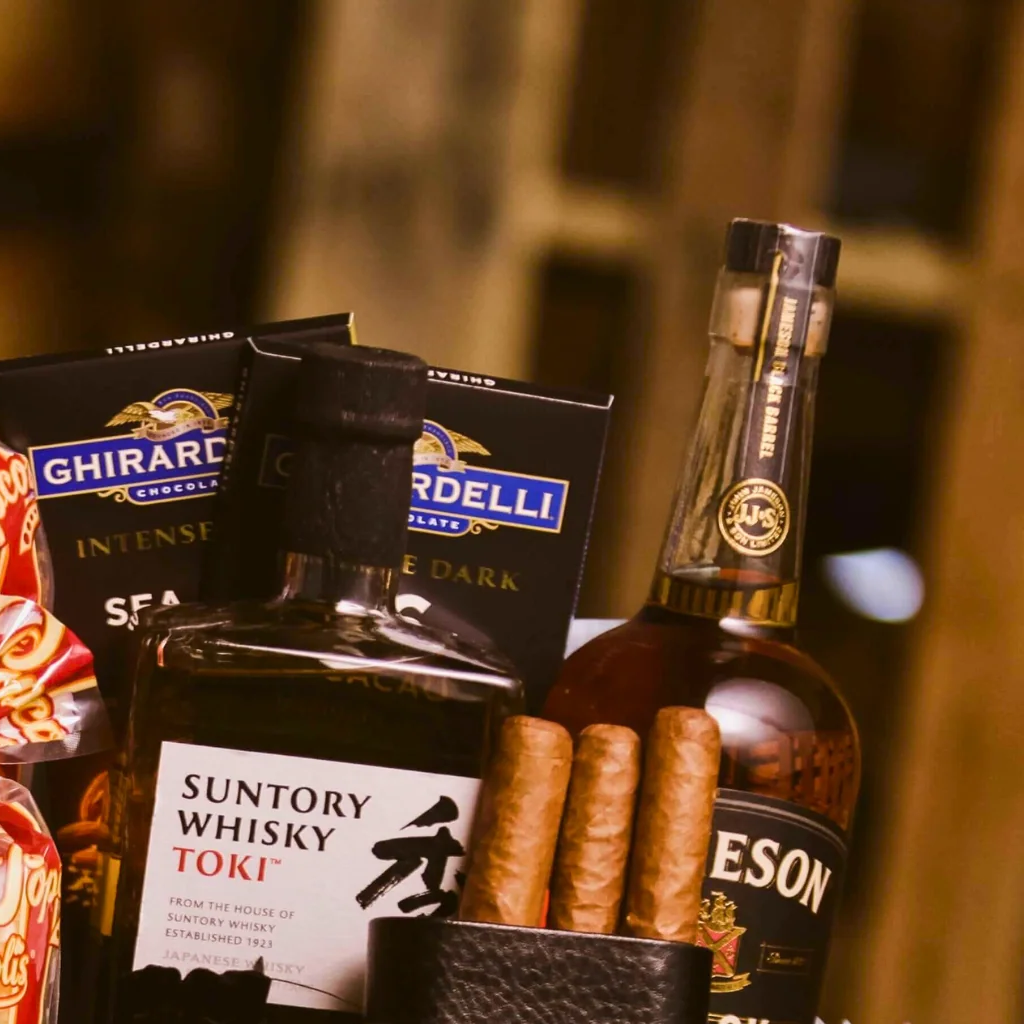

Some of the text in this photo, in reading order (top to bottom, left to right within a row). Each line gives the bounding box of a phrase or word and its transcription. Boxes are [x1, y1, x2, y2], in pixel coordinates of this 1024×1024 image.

[106, 331, 234, 354] GHIRARDELLI
[775, 297, 798, 356] JAMESON
[759, 406, 780, 460] BARREL
[43, 437, 227, 485] GHIRARD
[136, 480, 219, 498] CHOCOLA
[412, 472, 554, 520] RDELLI
[431, 559, 521, 592] DARK
[182, 774, 372, 820] SUNTORY
[177, 810, 336, 852] WHISKY
[710, 830, 832, 914] ESON
[167, 912, 276, 934] SUNTORY WHISKY
[169, 897, 295, 920] FROM THE HOUSE OF
[165, 928, 273, 949] ESTABLISHED 1923
[163, 949, 240, 968] JAPANESE
